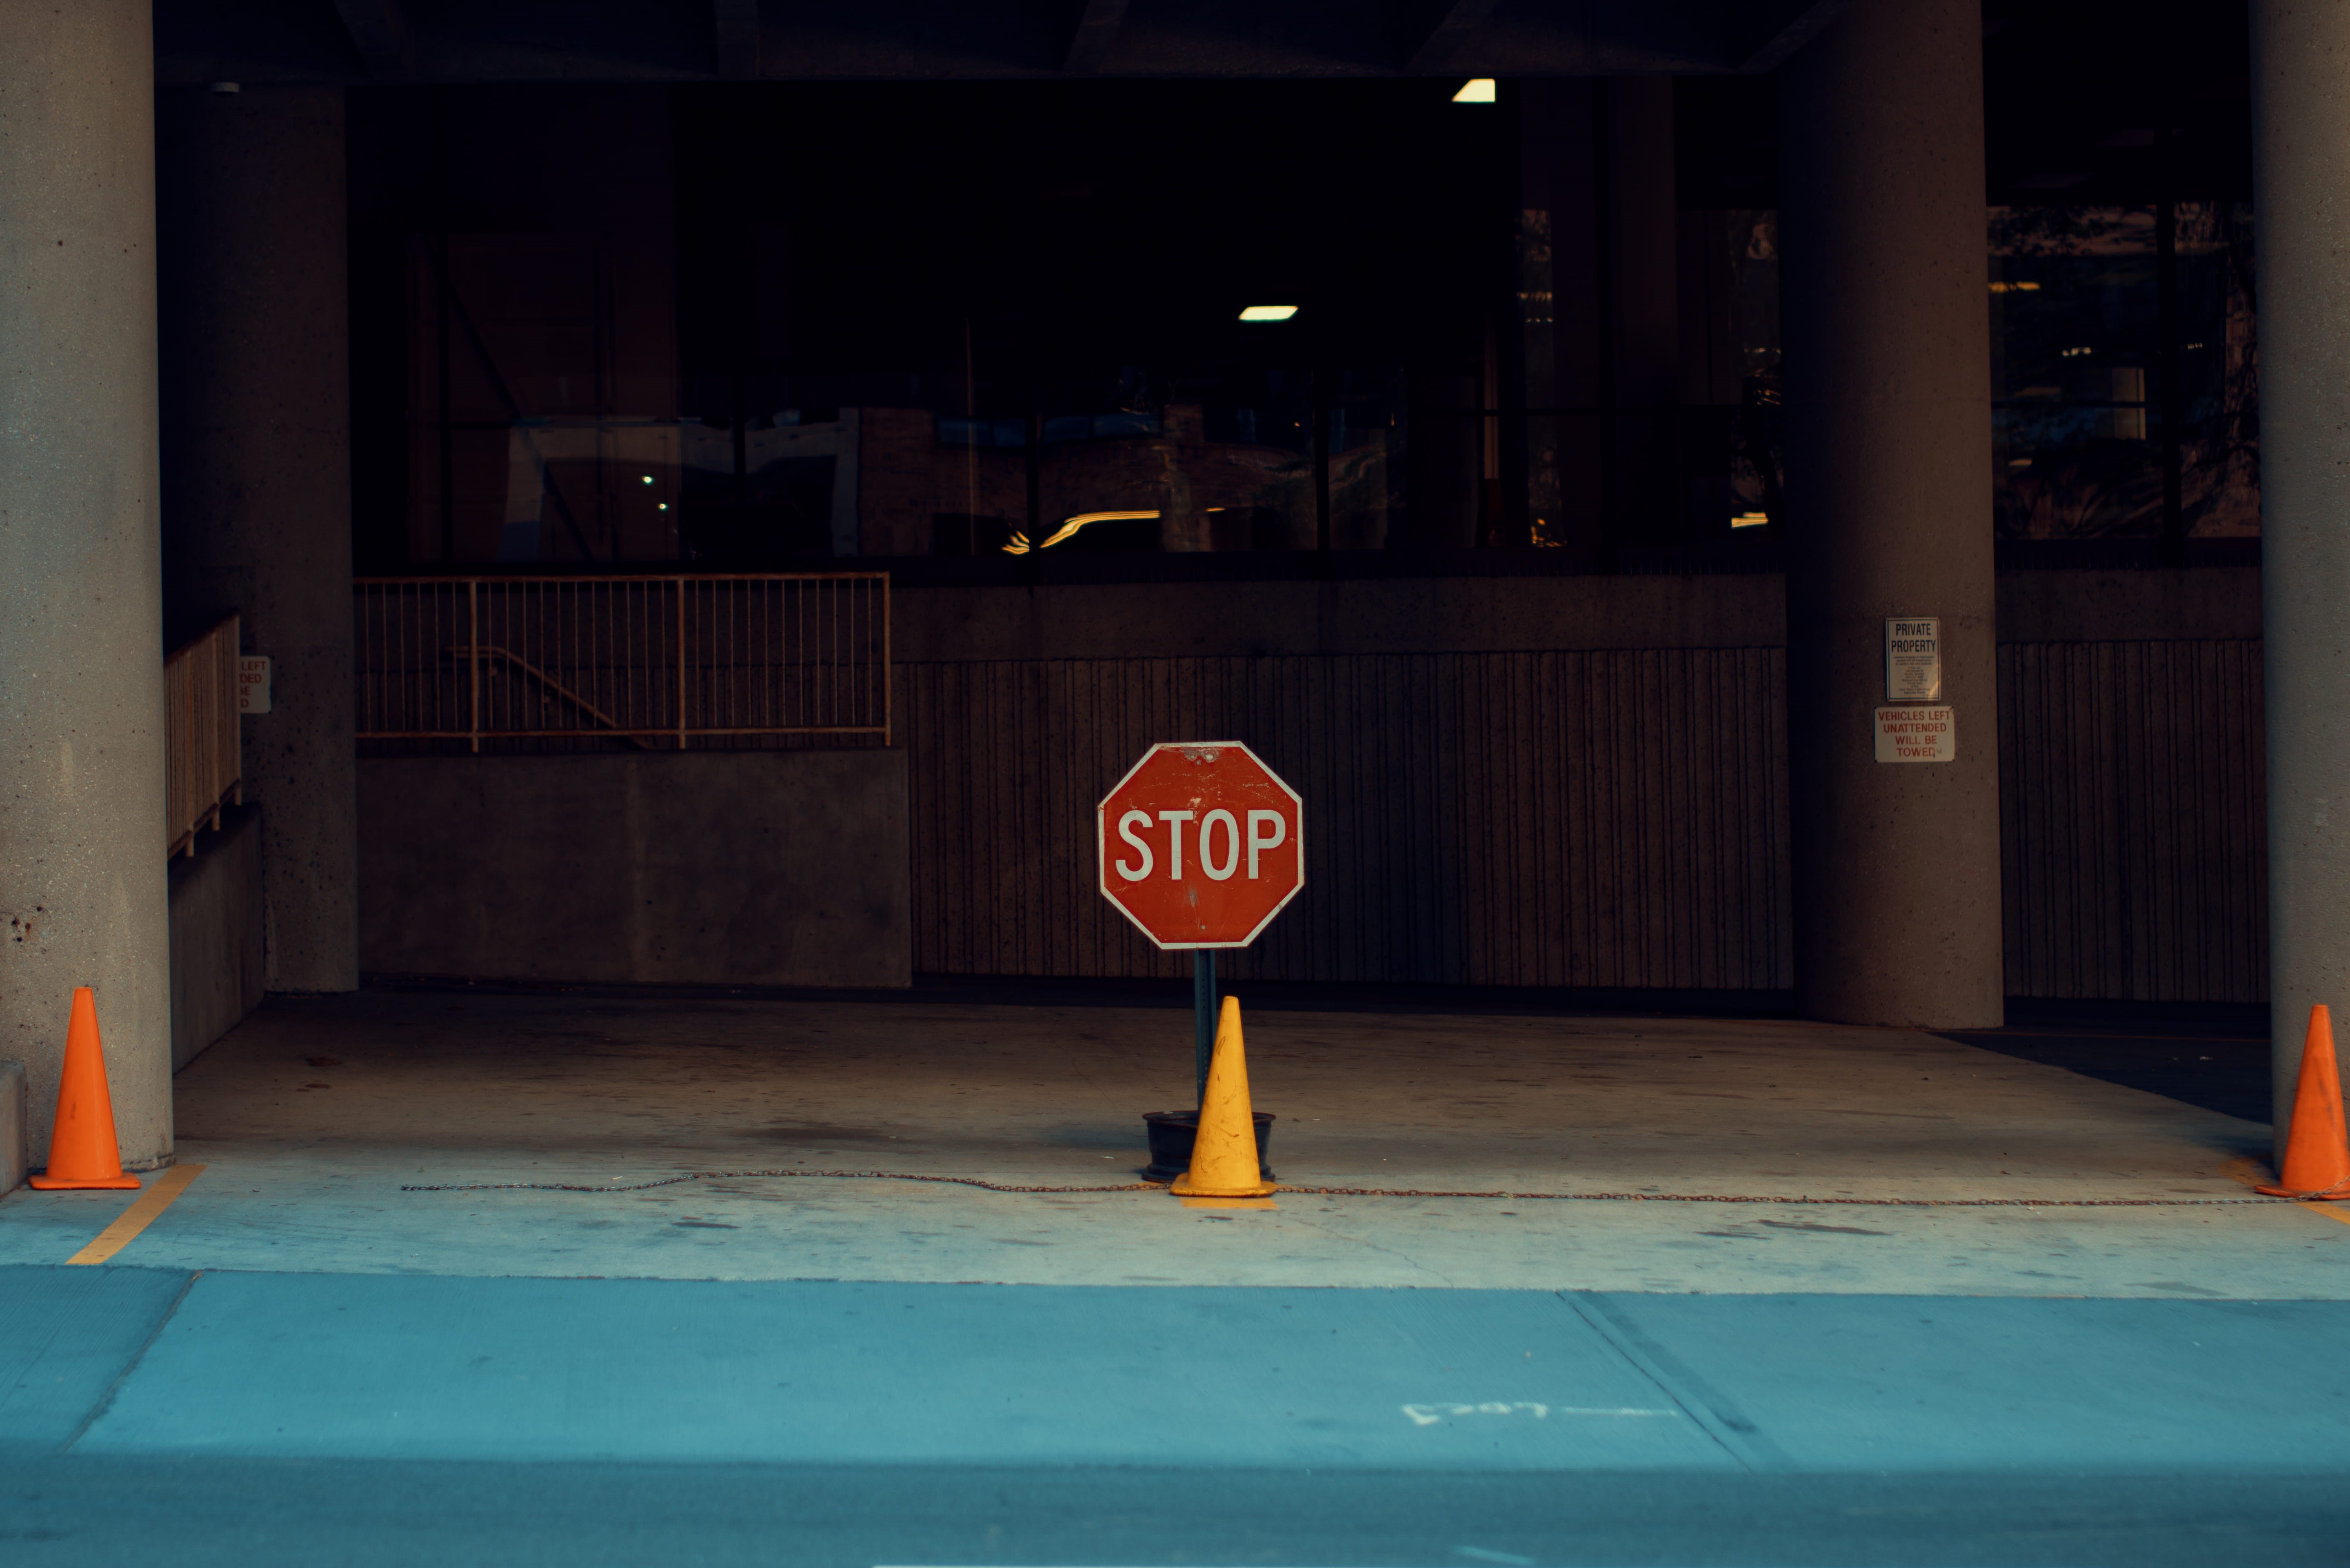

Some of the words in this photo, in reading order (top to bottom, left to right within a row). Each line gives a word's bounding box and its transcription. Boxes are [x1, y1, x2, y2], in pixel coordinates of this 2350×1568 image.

[1896, 623, 1931, 636] PRIVATE
[1891, 640, 1936, 652] PROPERTY
[241, 661, 266, 671] LEFT
[1878, 711, 1924, 721] VEHICLES
[1928, 711, 1950, 720] LEFT
[1883, 723, 1946, 733] UNATTENDED
[1895, 735, 1920, 744] WILL
[1925, 735, 1937, 744] BE
[1897, 747, 1935, 757] TOWED
[1115, 809, 1286, 881] STOP
